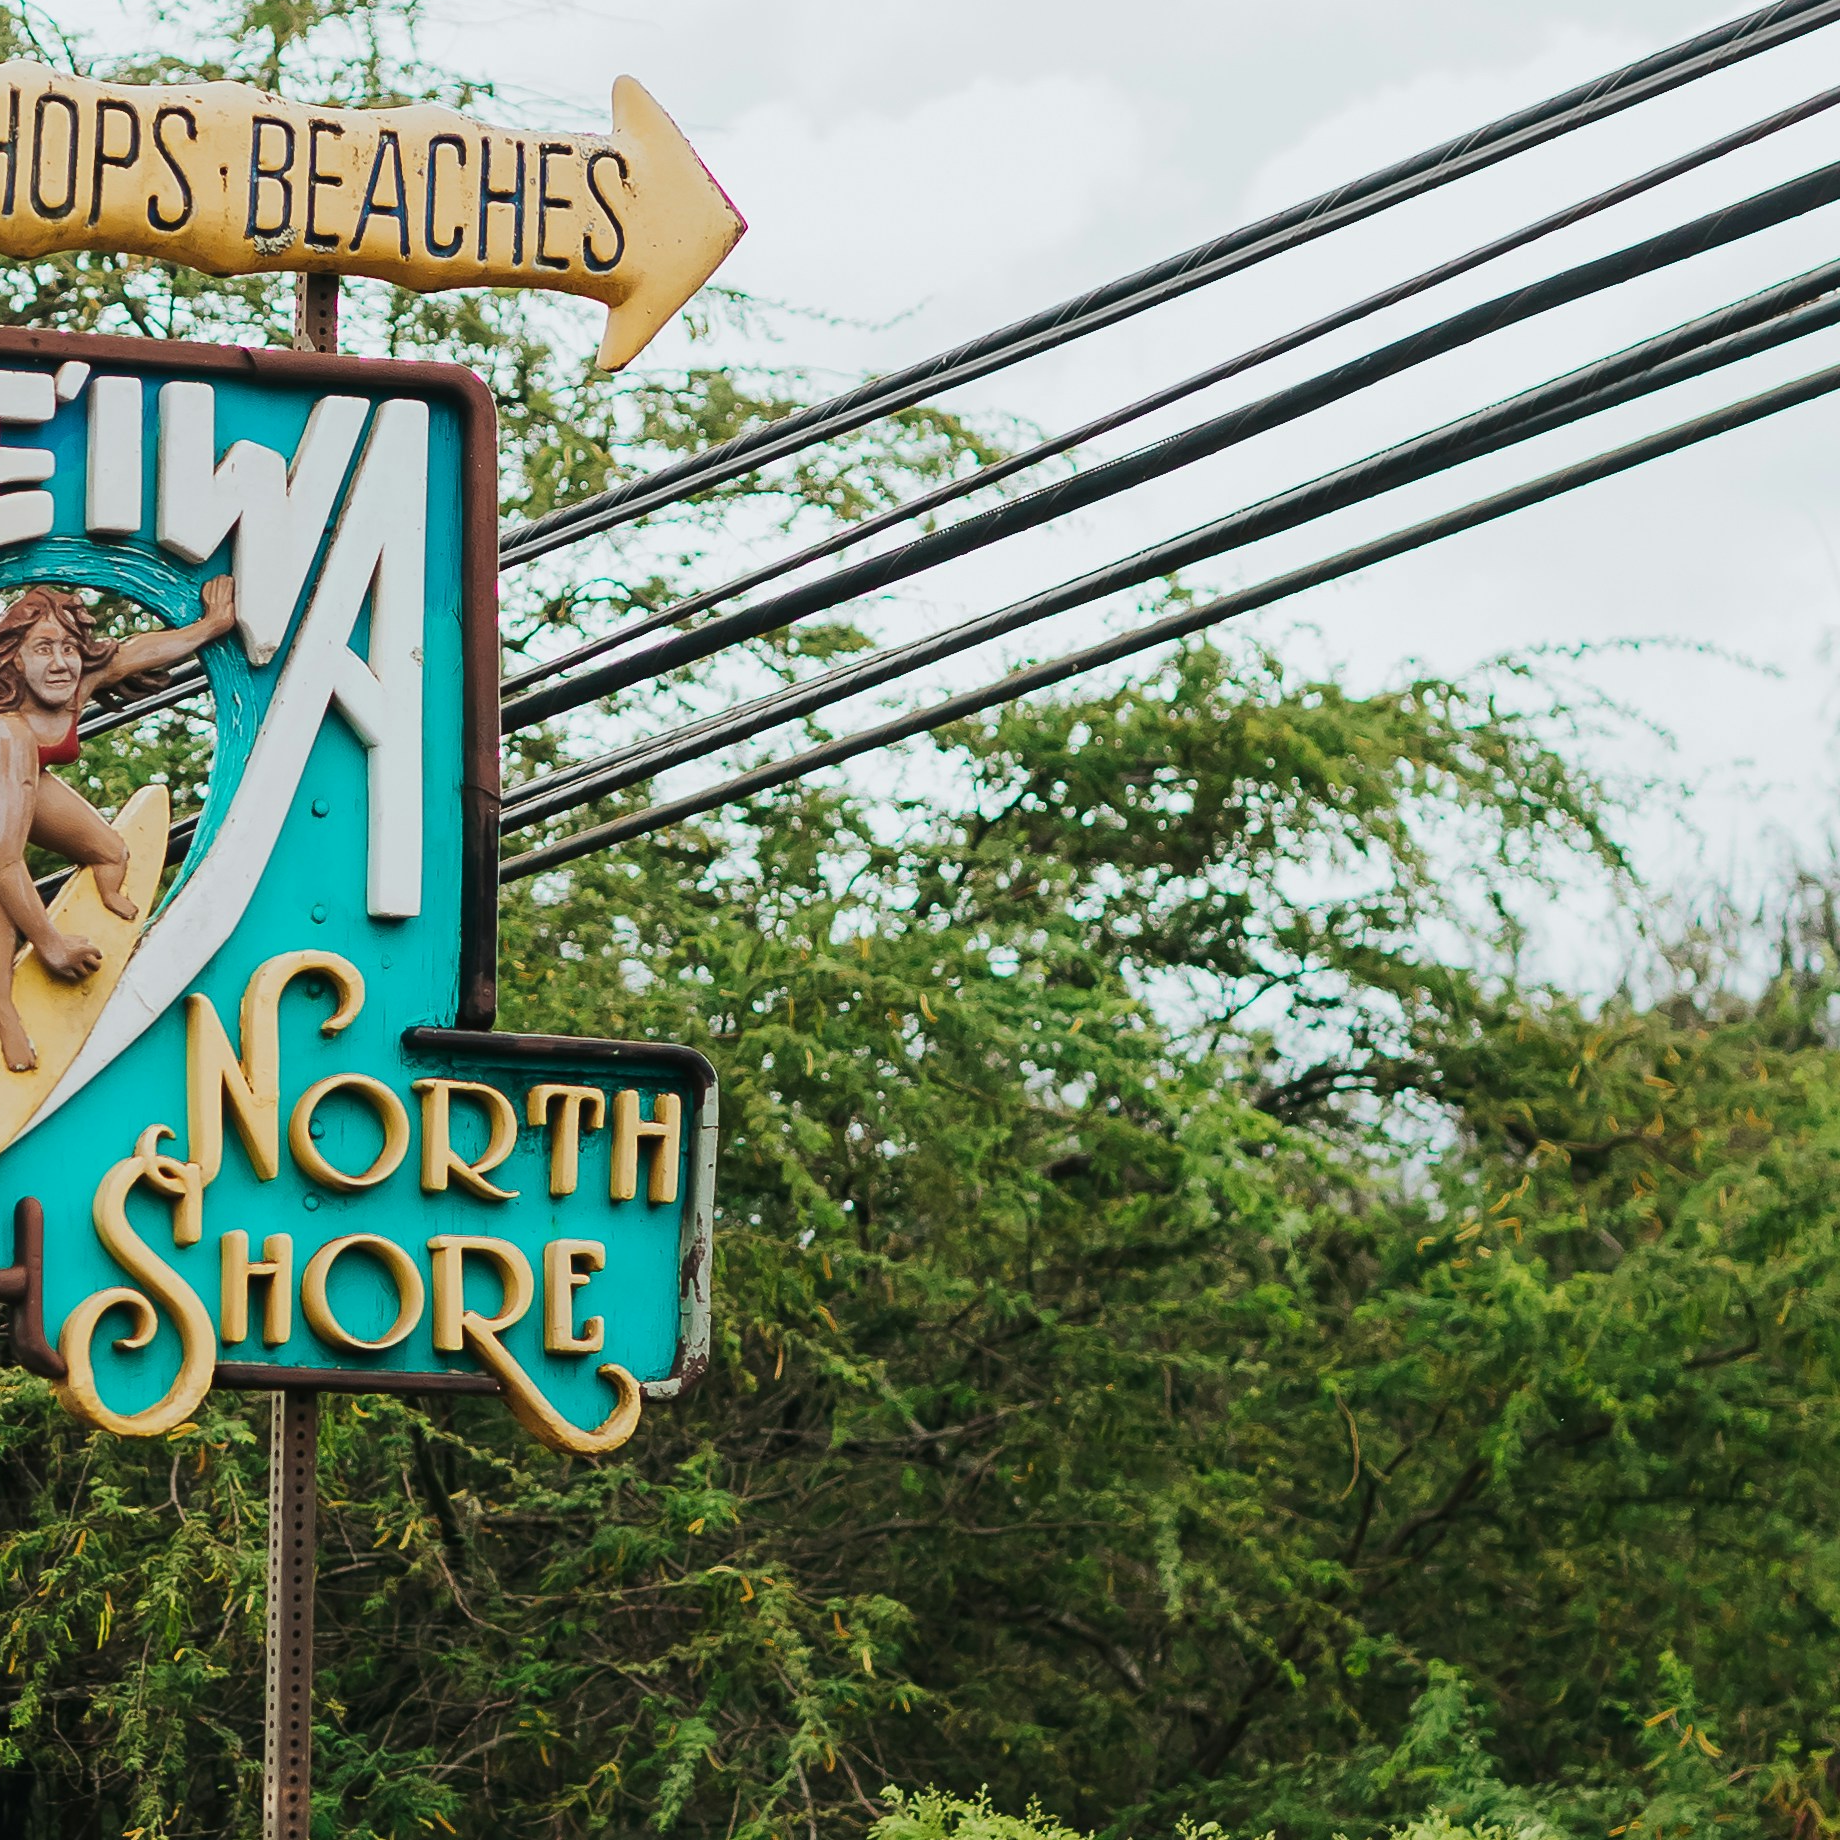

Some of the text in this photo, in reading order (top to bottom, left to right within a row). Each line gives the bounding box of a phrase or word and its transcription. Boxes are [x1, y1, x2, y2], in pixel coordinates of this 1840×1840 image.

[243, 115, 630, 273] BEACHES
[185, 949, 681, 1205] NORTH
[59, 1123, 642, 1455] SHORE
